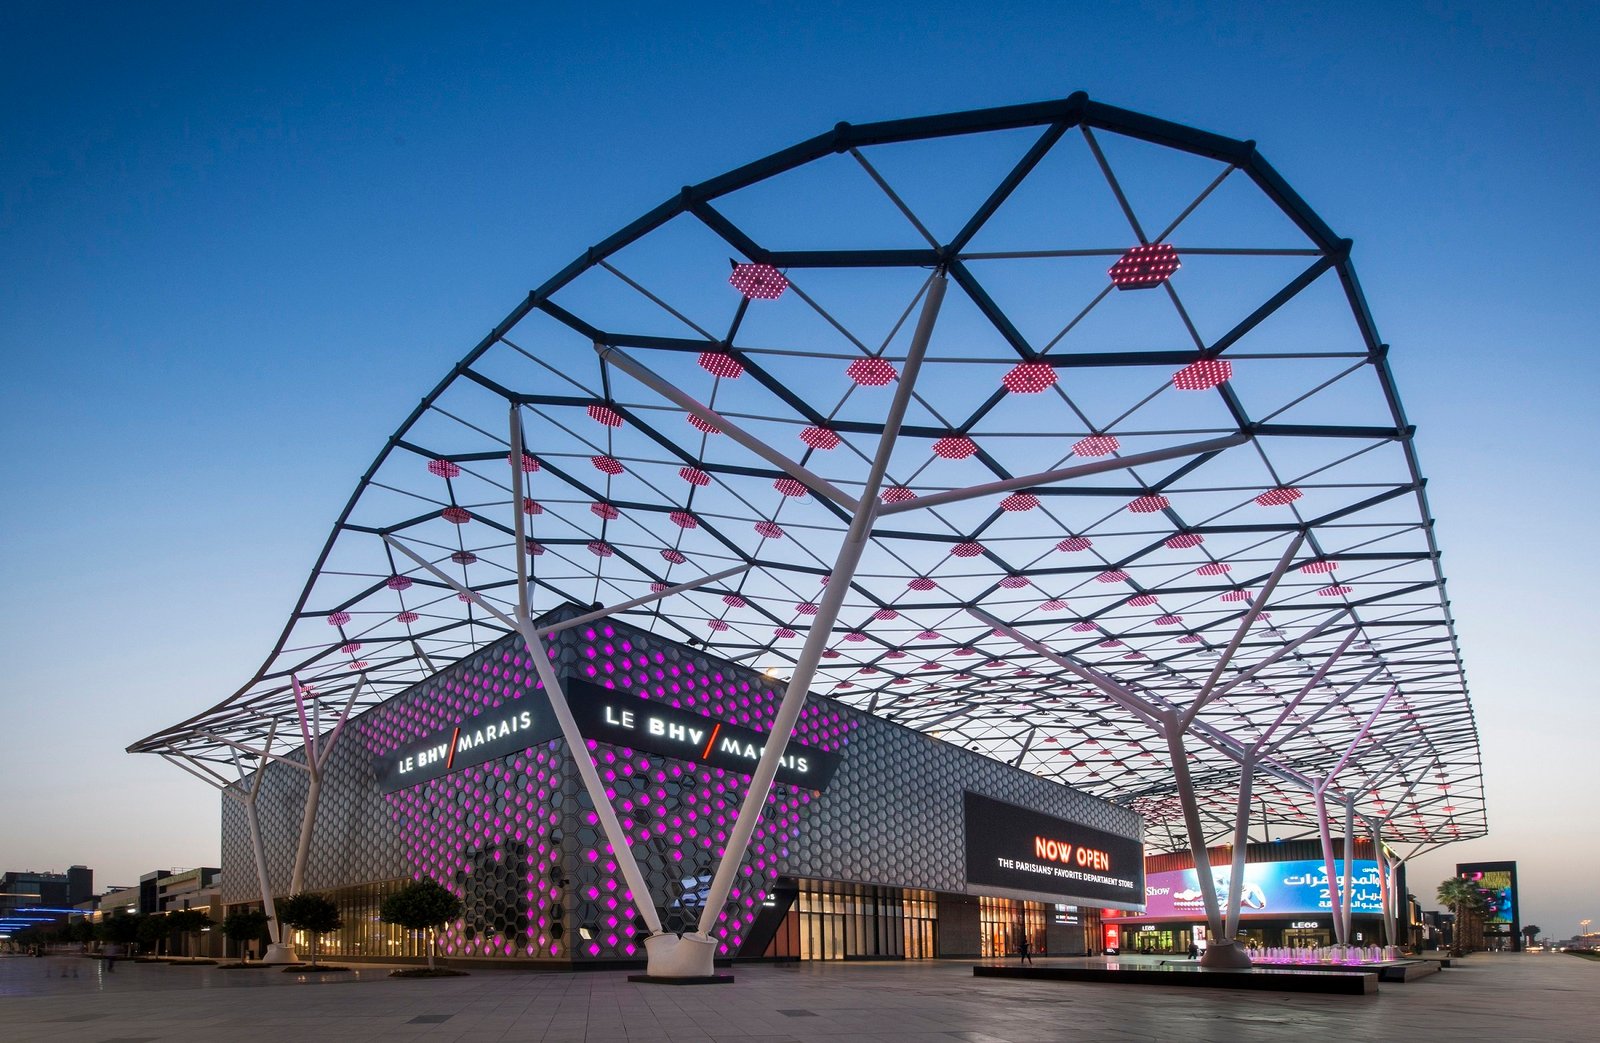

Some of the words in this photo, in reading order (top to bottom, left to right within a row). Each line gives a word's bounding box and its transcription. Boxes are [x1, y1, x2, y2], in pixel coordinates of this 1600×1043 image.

[606, 706, 634, 729] LE
[399, 757, 414, 774] LE
[1035, 836, 1071, 863] NOW
[1076, 847, 1109, 871] OPEN
[998, 857, 1014, 869] THE
[1054, 868, 1082, 881] FAVORITE
[1083, 873, 1118, 887] DEPARTMENT
[1118, 879, 1134, 889] STORE
[1146, 887, 1170, 896] Show
